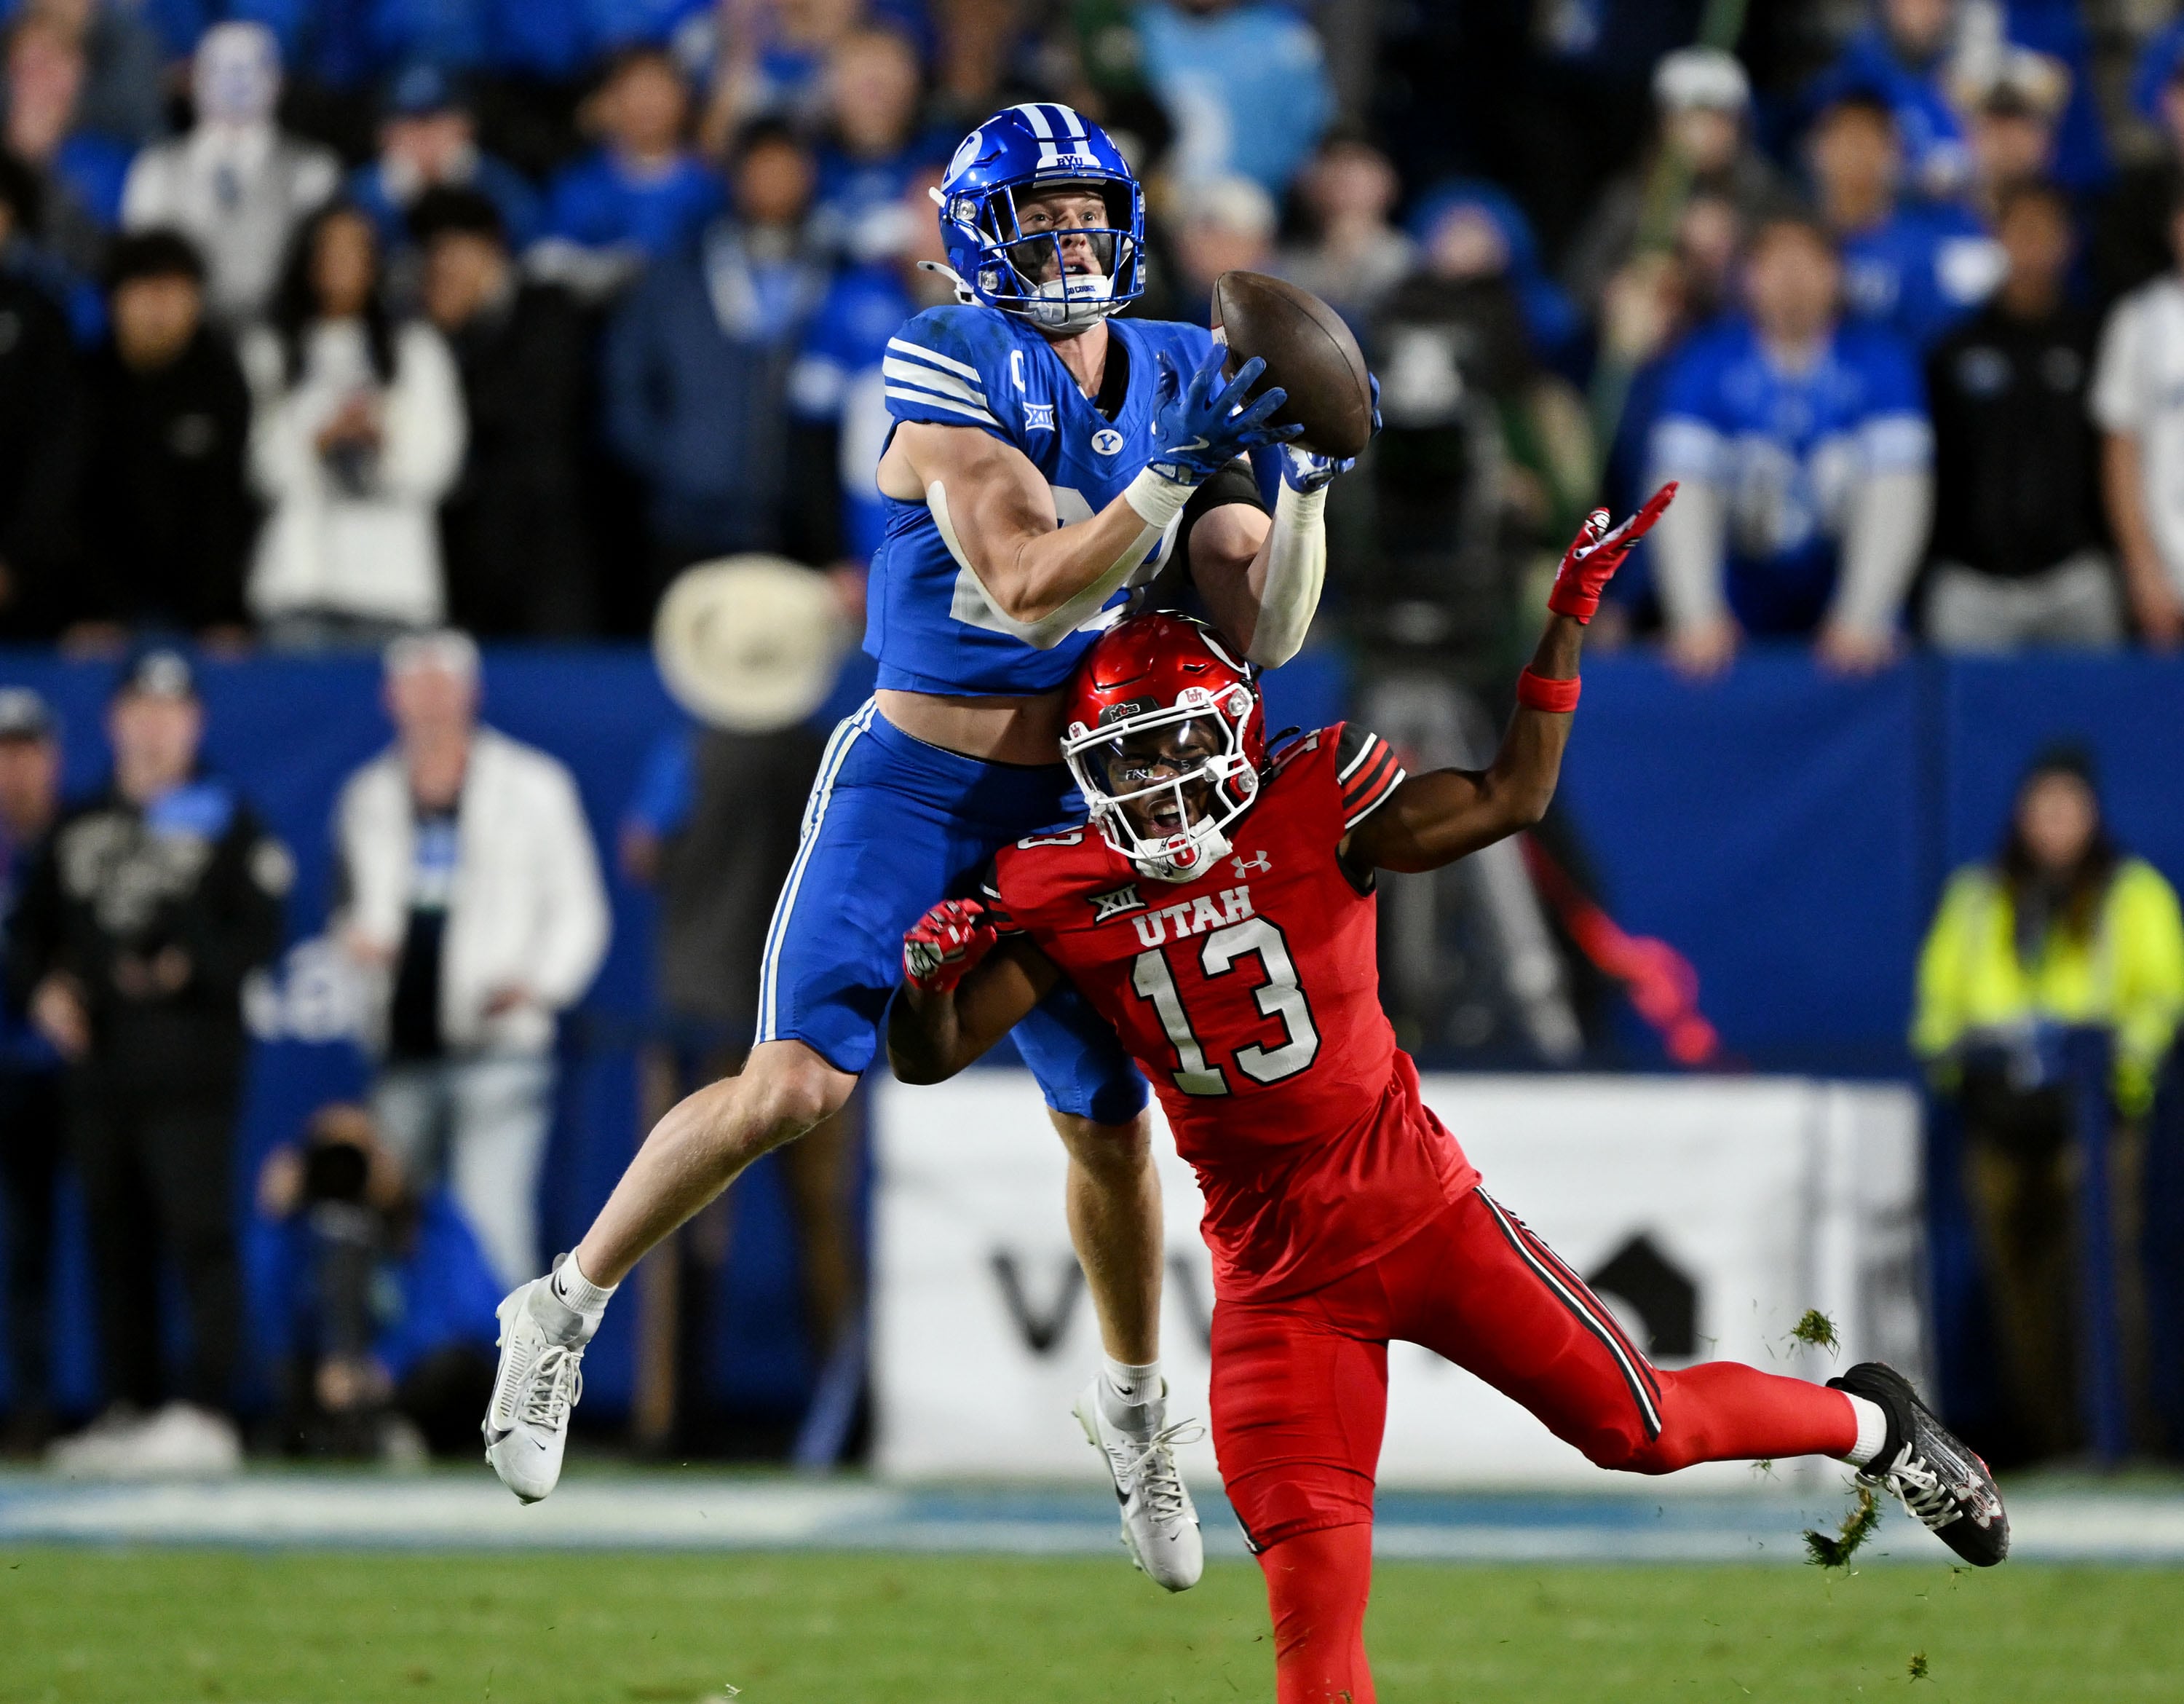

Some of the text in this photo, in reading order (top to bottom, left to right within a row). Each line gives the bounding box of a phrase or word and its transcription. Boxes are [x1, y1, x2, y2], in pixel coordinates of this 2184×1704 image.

[1056, 155, 1083, 167] BYU
[1088, 883, 1148, 923] XII
[1132, 885, 1255, 947] UTAH
[1131, 915, 1321, 1097] 13
